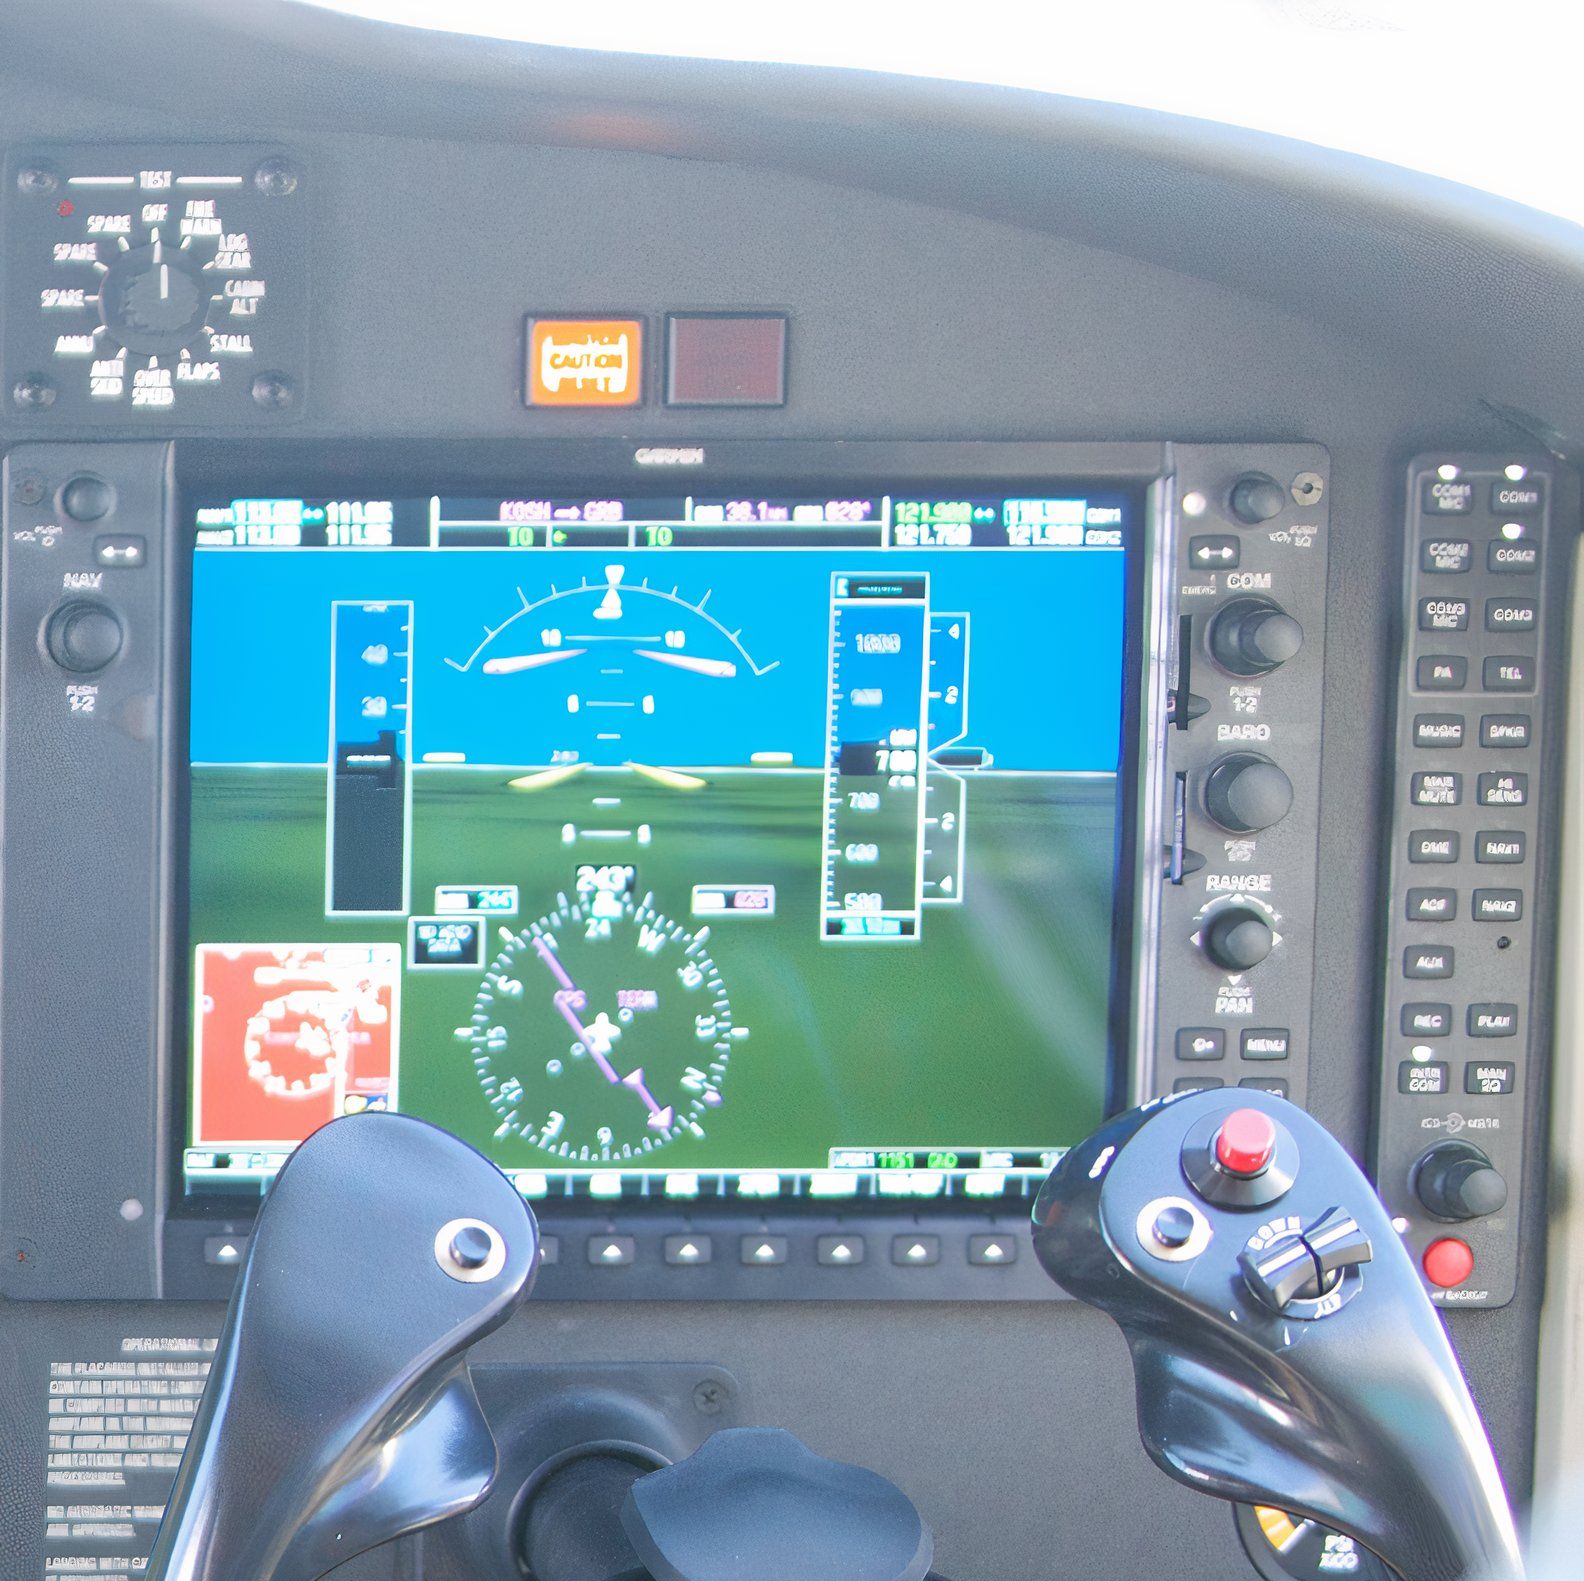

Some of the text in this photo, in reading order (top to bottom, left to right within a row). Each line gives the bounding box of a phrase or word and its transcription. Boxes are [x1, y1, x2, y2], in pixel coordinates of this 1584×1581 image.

[87, 215, 131, 233] SPARE
[53, 242, 97, 261] SPARE
[41, 289, 86, 306] SPARE
[210, 334, 253, 353] STALL
[176, 362, 220, 381] FLAPS
[1226, 573, 1271, 588] COM
[1217, 725, 1270, 741] BARO
[1206, 875, 1271, 892] RANGE
[1215, 997, 1253, 1014] PAN
